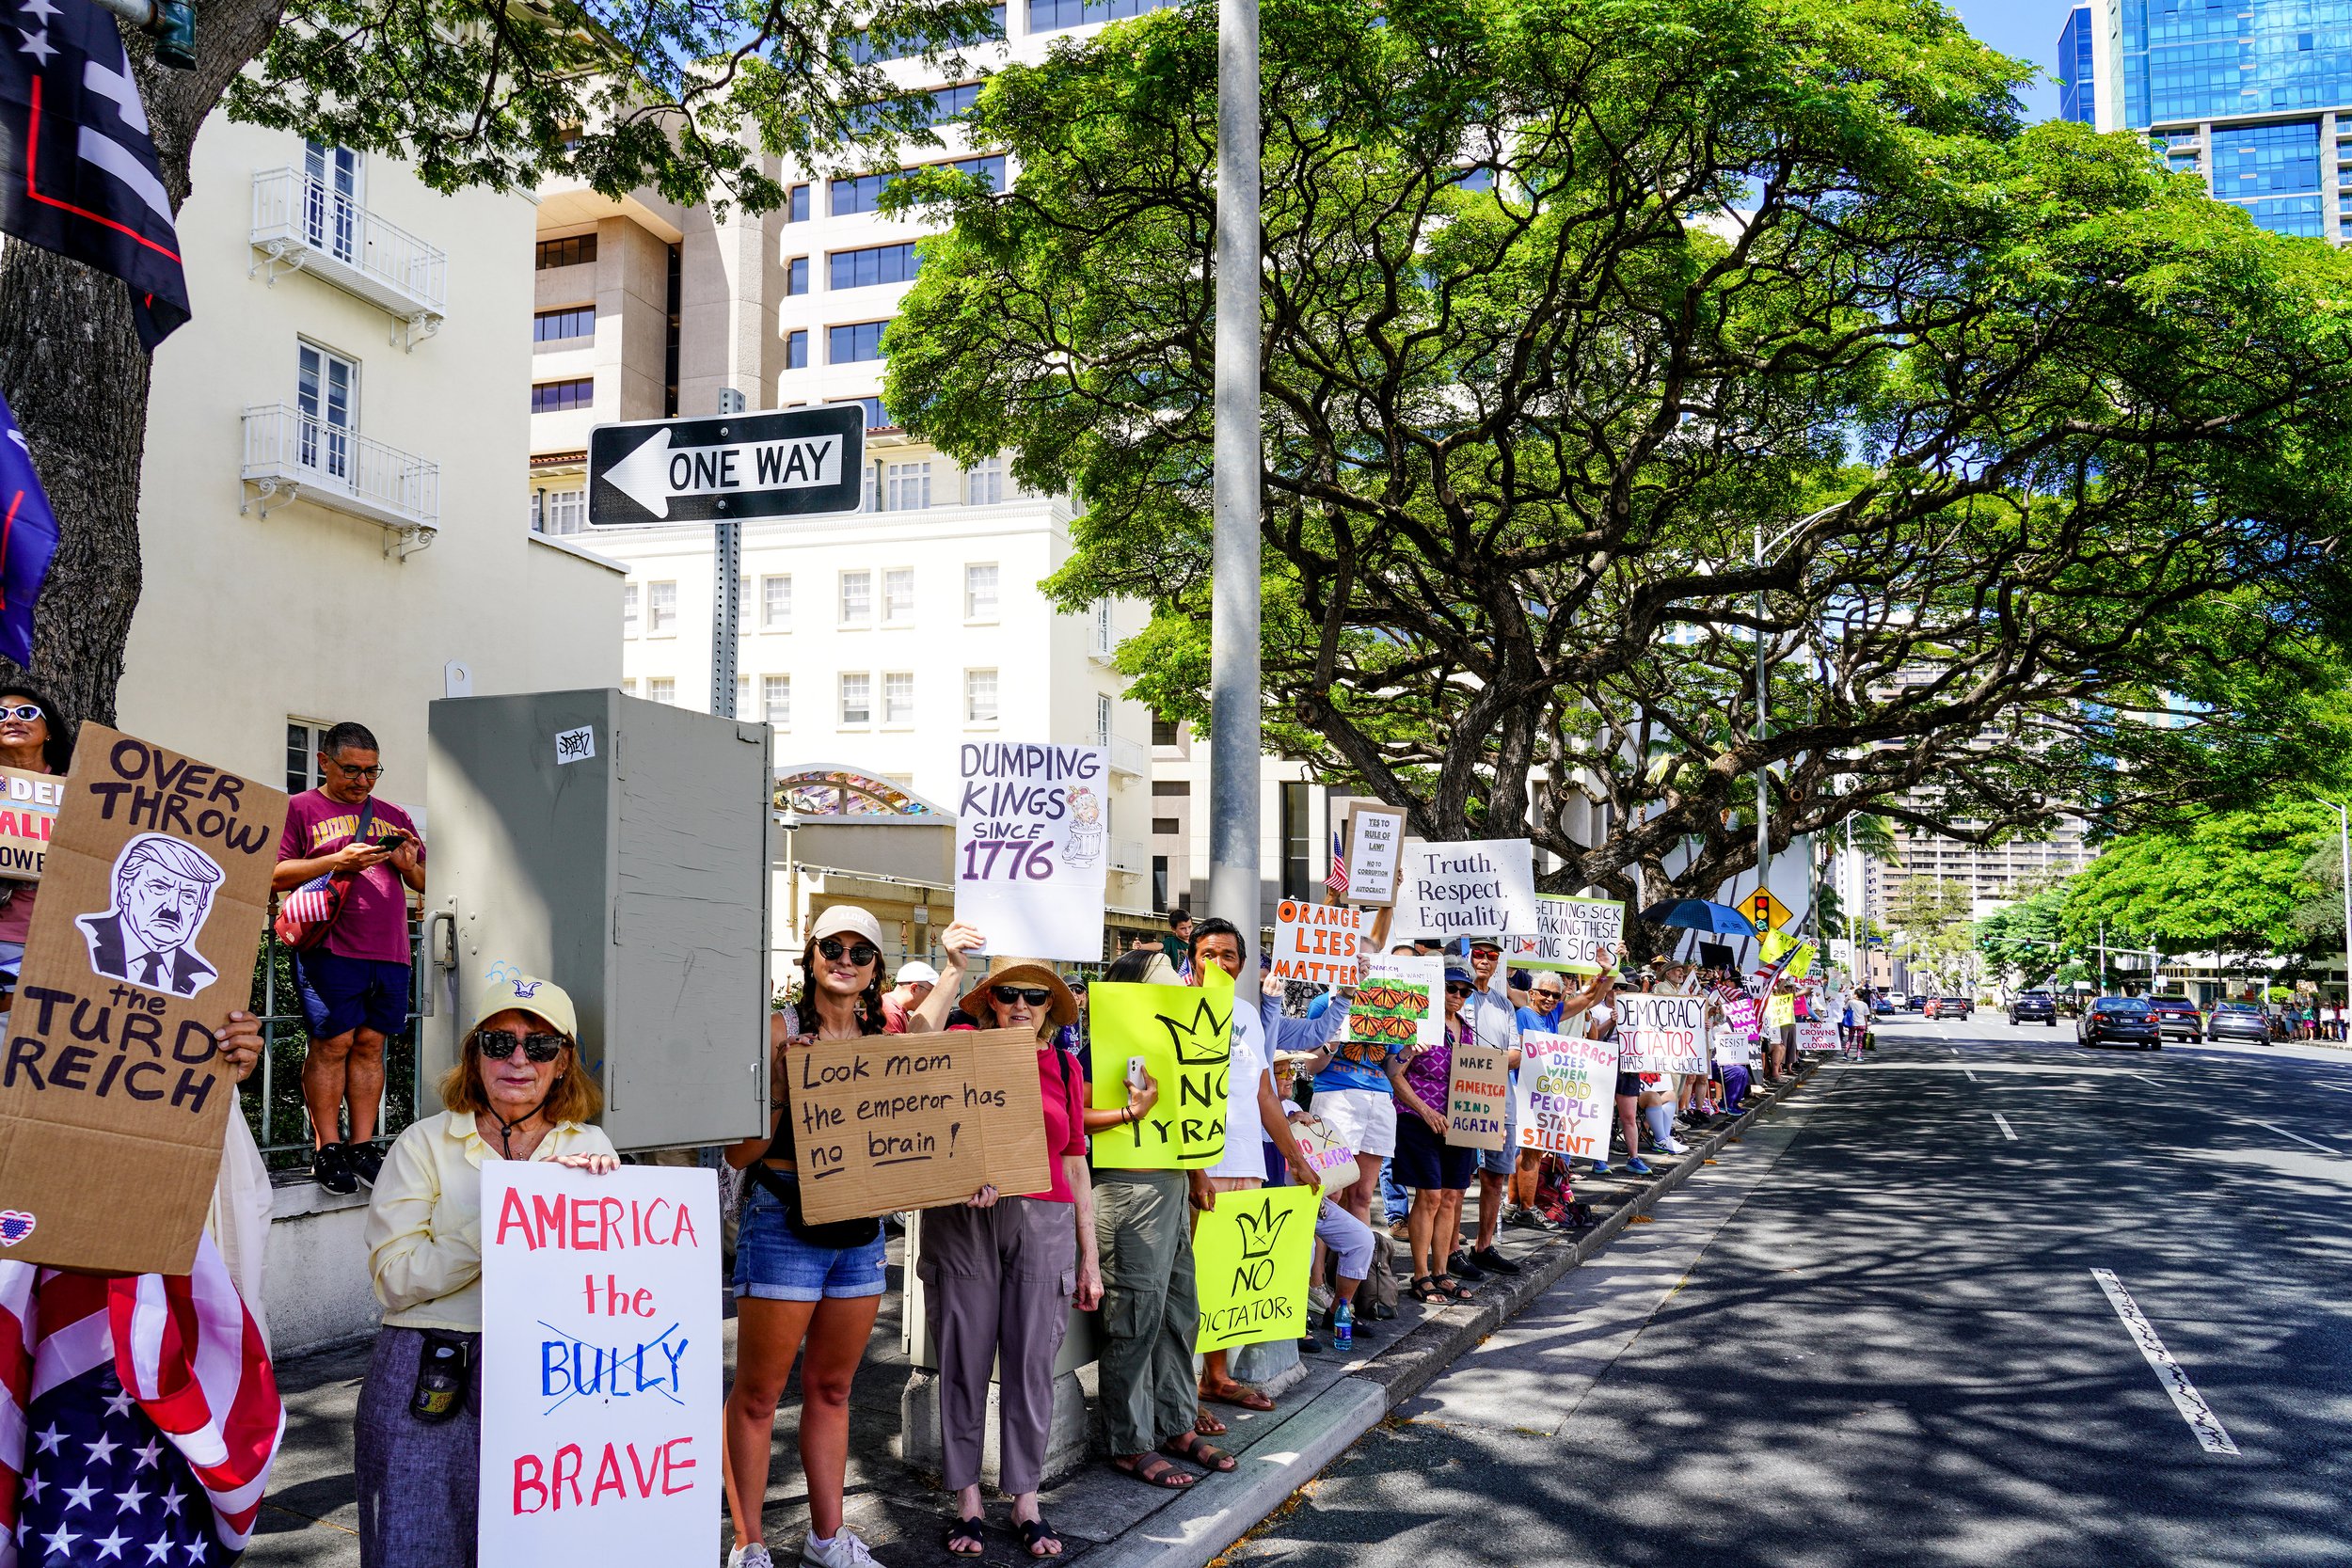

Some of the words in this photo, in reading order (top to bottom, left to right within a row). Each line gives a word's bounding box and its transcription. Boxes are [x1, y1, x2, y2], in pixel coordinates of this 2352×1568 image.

[669, 449, 740, 491] ONE
[755, 440, 833, 484] WAY
[961, 742, 1101, 781] DUMPING
[110, 739, 245, 813] OVER
[960, 781, 1066, 820] KINGS
[0, 810, 56, 842] ALI
[89, 782, 270, 855] THROW
[311, 815, 360, 849] ARIZON
[973, 821, 1046, 839] SINCE
[1368, 818, 1380, 828] YES
[1364, 830, 1381, 839] RULE
[962, 839, 1055, 880] 1776
[1278, 900, 1360, 928] ORANGE
[1420, 904, 1509, 934] Equality
[1590, 906, 1621, 922] SICK
[1295, 927, 1356, 957] LIES
[1581, 921, 1619, 939] THESE
[1833, 950, 1847, 958] 25
[1274, 959, 1359, 985] MATTER
[108, 984, 167, 1016] the
[1616, 999, 1707, 1029] DEMOCRACY
[1722, 999, 1751, 1014] DUE
[24, 986, 218, 1064] TURD
[1525, 1039, 1617, 1067] DEMOCRACY
[1617, 1030, 1697, 1057] DICTATOR
[1719, 1037, 1745, 1048] RESIST
[4, 1036, 216, 1114] REICH
[802, 1053, 870, 1089] Look
[884, 1053, 952, 1077] mom
[1459, 1057, 1493, 1070] MAKE
[1546, 1065, 1588, 1082] WHEN
[1553, 1053, 1586, 1069] DIES
[1654, 1057, 1669, 1072] THE
[1671, 1057, 1705, 1073] CHOICE
[1454, 1079, 1505, 1098] AMERICA
[1536, 1075, 1592, 1100] GOOD
[802, 1101, 846, 1134] the
[857, 1093, 954, 1120] emperor
[963, 1082, 1007, 1108] has
[1454, 1100, 1490, 1115] KIND
[1530, 1091, 1599, 1119] PEOPLE
[1133, 1112, 1227, 1148] TYRA
[1452, 1117, 1499, 1132] AGAIN
[1536, 1112, 1581, 1133] STAY
[1523, 1128, 1595, 1155] SILENT
[811, 1145, 843, 1168] no
[496, 1186, 699, 1251] AMERICA
[1231, 1259, 1275, 1298] NO
[580, 1273, 657, 1318] the
[541, 1338, 689, 1397] BULLY
[513, 1435, 697, 1517] BRAVE
